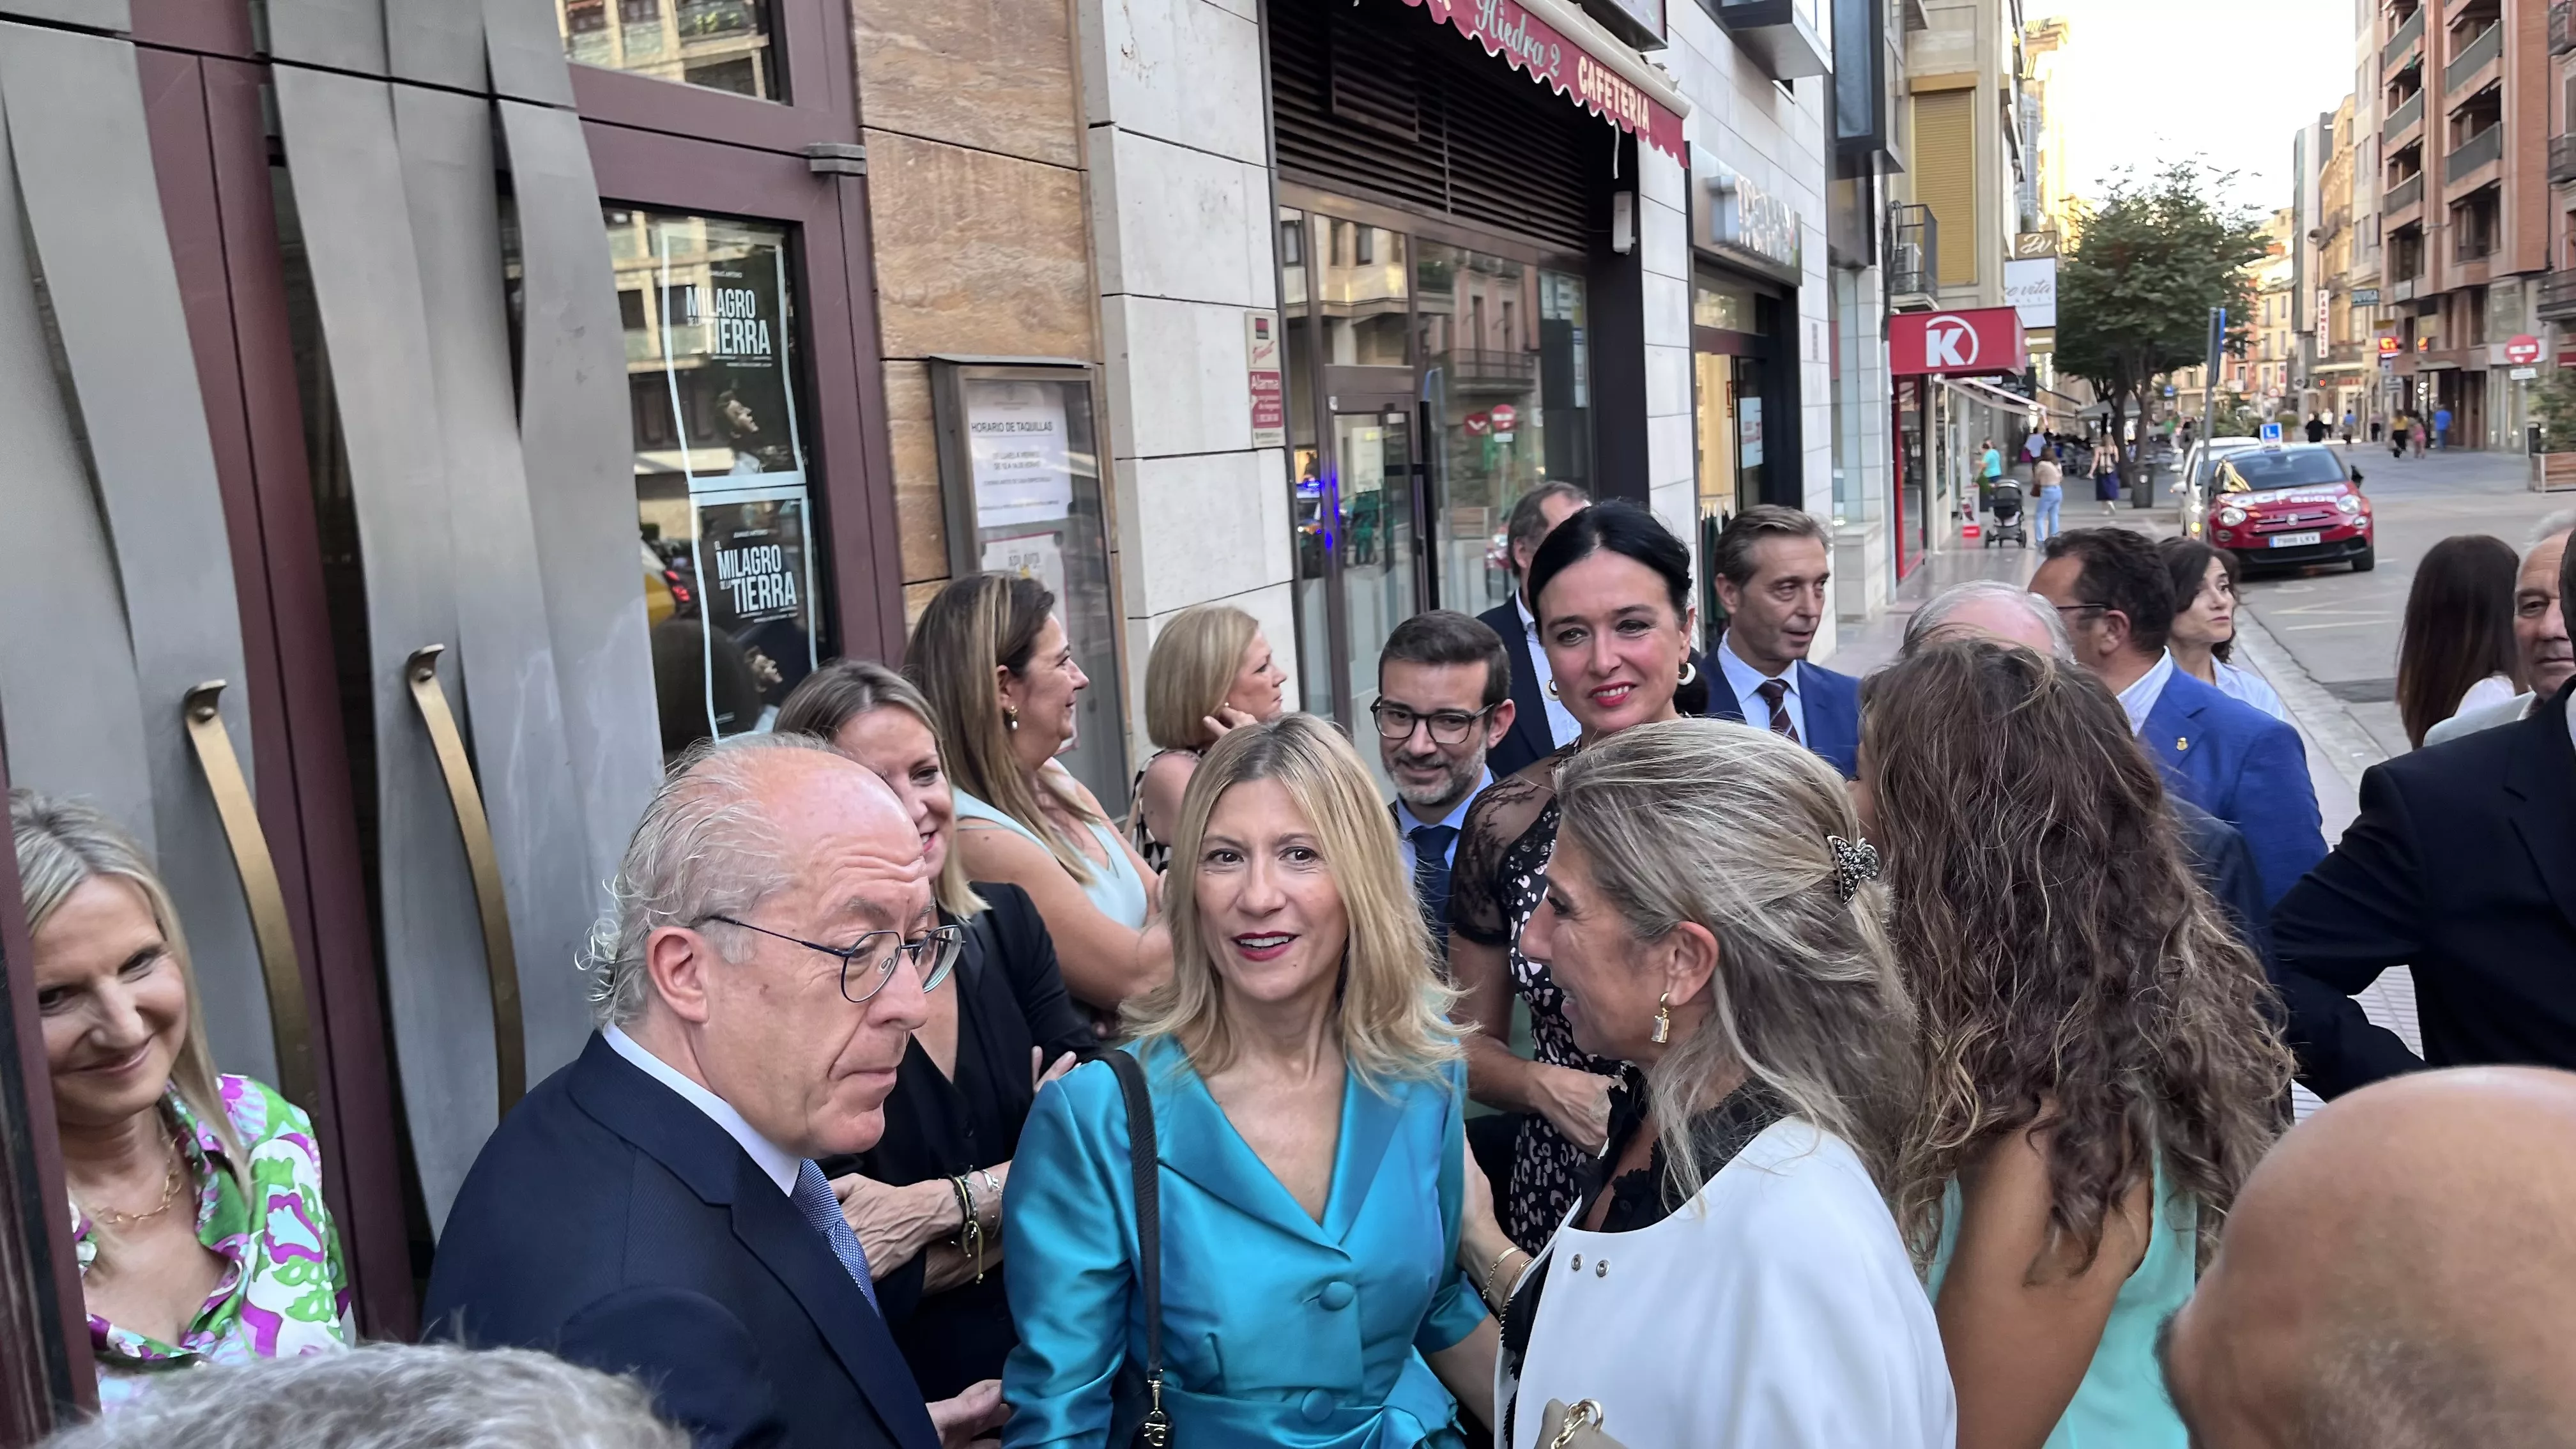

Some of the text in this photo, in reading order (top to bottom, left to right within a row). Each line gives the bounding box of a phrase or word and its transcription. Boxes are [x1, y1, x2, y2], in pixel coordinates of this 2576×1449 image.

[1550, 43, 1561, 77] 2
[1577, 56, 1650, 133] CAFETERIA
[686, 286, 756, 319] MILAGRO
[702, 318, 772, 355] TIERRA
[1926, 326, 1966, 368] K
[971, 421, 1052, 433] HORARIO DE TAQUILLAS
[2267, 426, 2276, 436] L
[716, 544, 782, 580] MILAGRO
[731, 571, 797, 614] TIERRA
